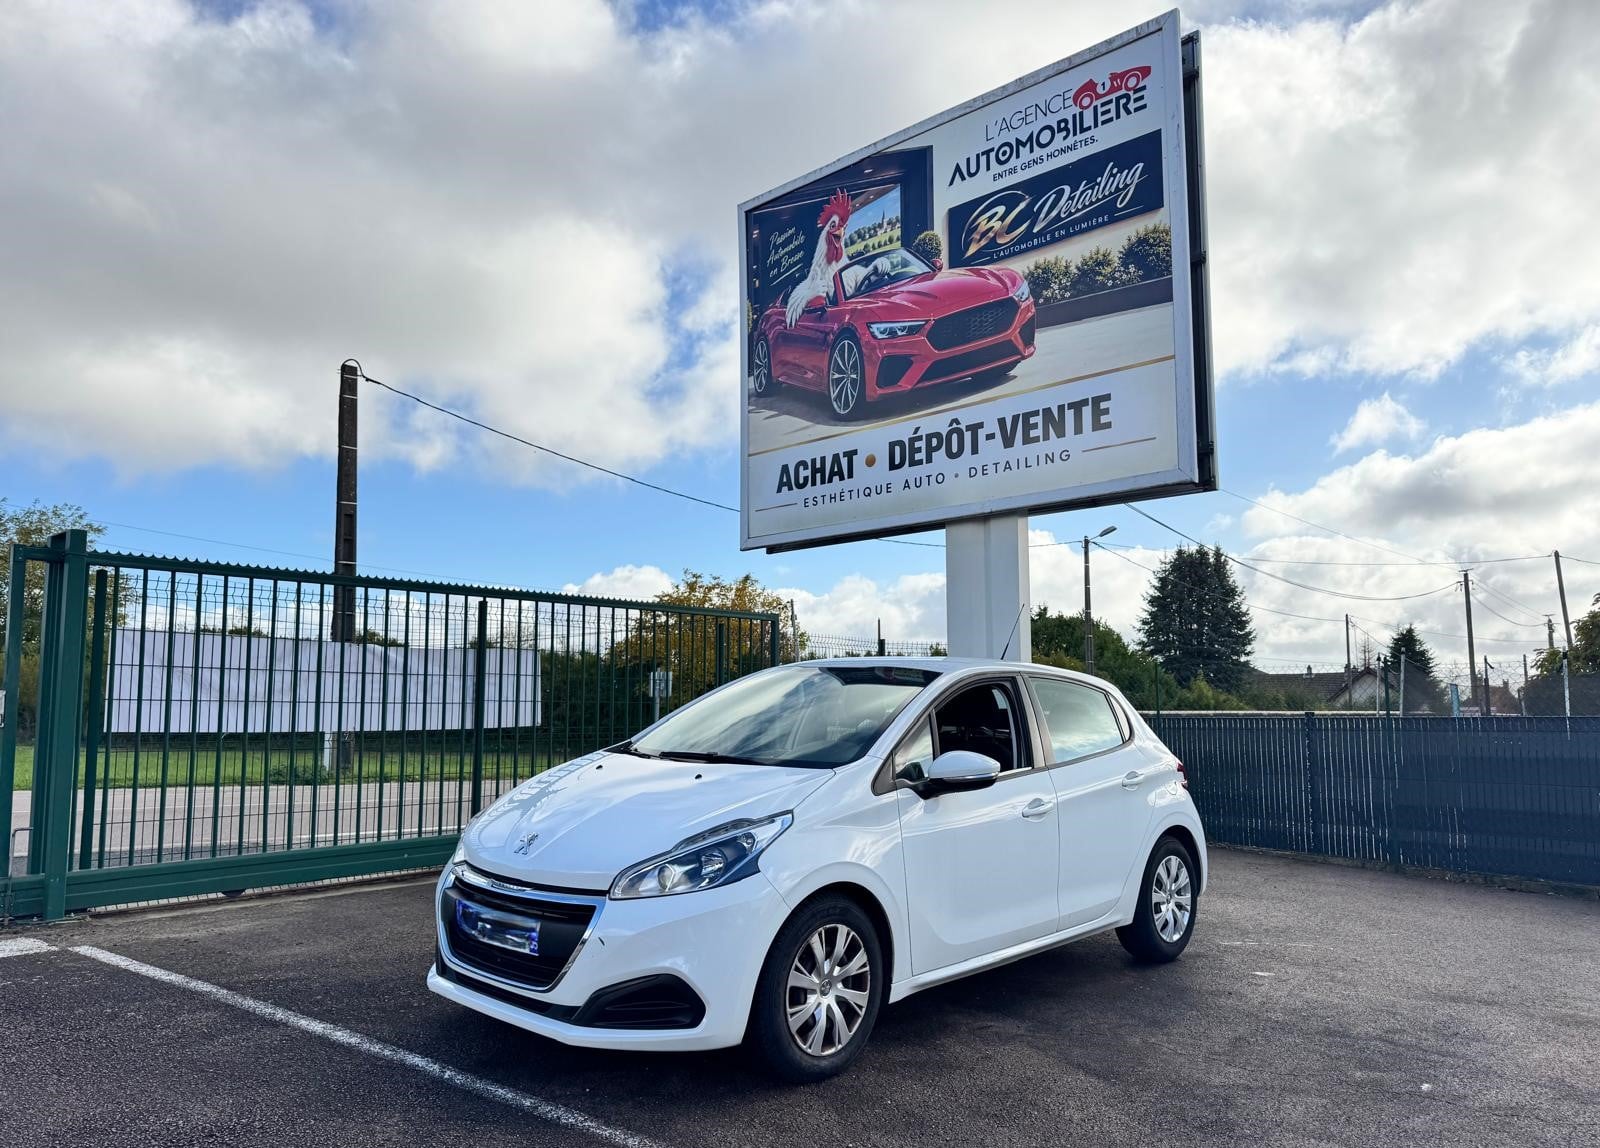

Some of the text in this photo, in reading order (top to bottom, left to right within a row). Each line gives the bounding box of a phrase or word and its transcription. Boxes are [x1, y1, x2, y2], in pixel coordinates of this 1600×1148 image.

[1100, 81, 1106, 91] 1
[985, 88, 1073, 142] L'AGENCE
[992, 136, 1098, 182] ENTRE GENS HONNÊTES.
[1033, 161, 1149, 234] Detailing
[993, 213, 1109, 259] L'AUTOMOBILE EN LUMIÈRE
[776, 392, 1112, 494] ACHAT DÉPÔT-VENTE
[803, 449, 1071, 508] ESTHÉTIQUE AUTO DETAILING
